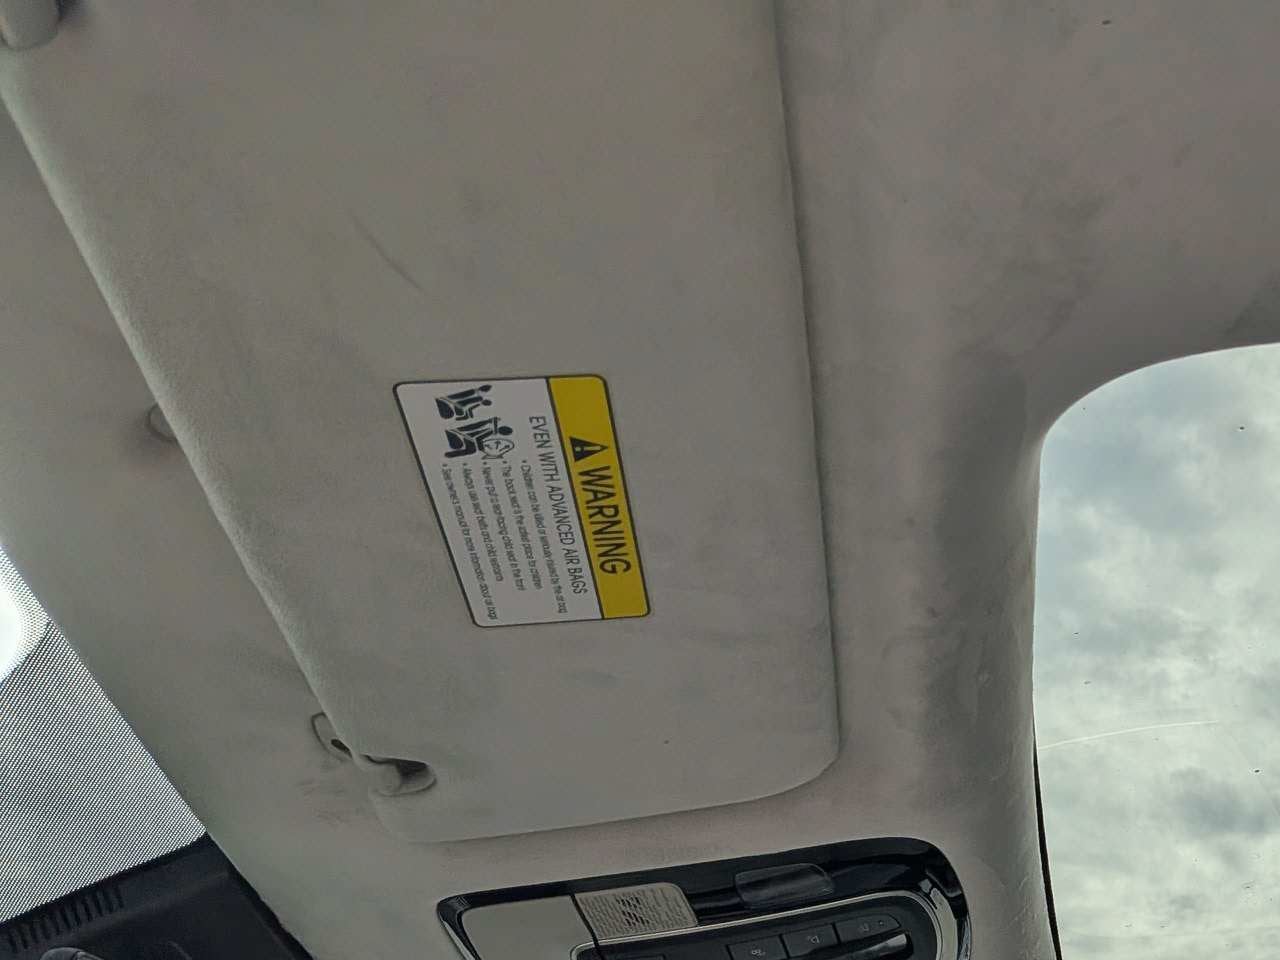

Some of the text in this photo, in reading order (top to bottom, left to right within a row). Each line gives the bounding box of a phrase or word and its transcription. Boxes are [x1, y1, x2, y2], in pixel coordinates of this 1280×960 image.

[527, 414, 588, 594] EVEN WITH ADVANCED AIR BAGS
[577, 465, 632, 575] WARNING
